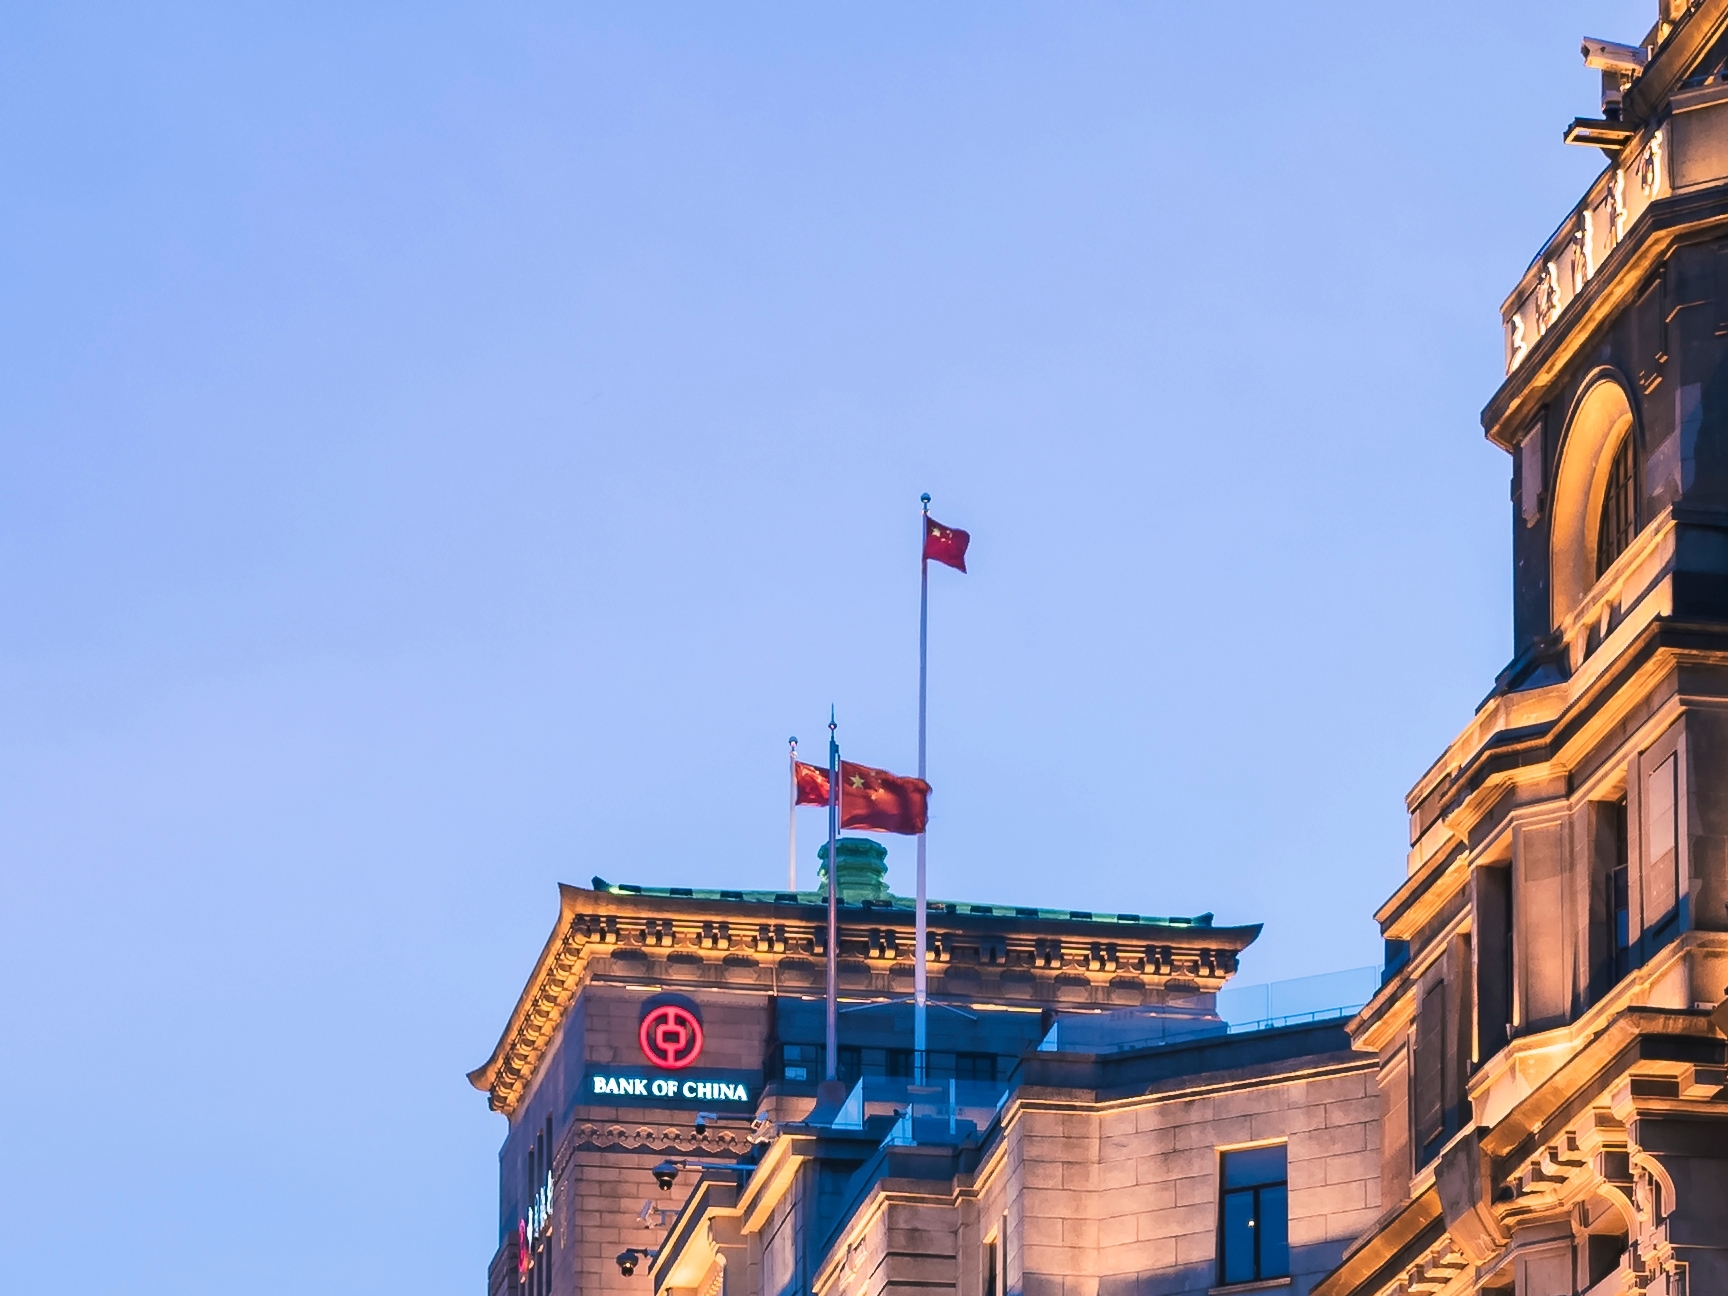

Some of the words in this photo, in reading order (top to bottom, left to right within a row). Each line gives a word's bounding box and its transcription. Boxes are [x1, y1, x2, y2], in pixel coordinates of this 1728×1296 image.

[593, 1076, 647, 1095] BANK
[652, 1079, 678, 1097] OF
[682, 1081, 748, 1101] CHINA
